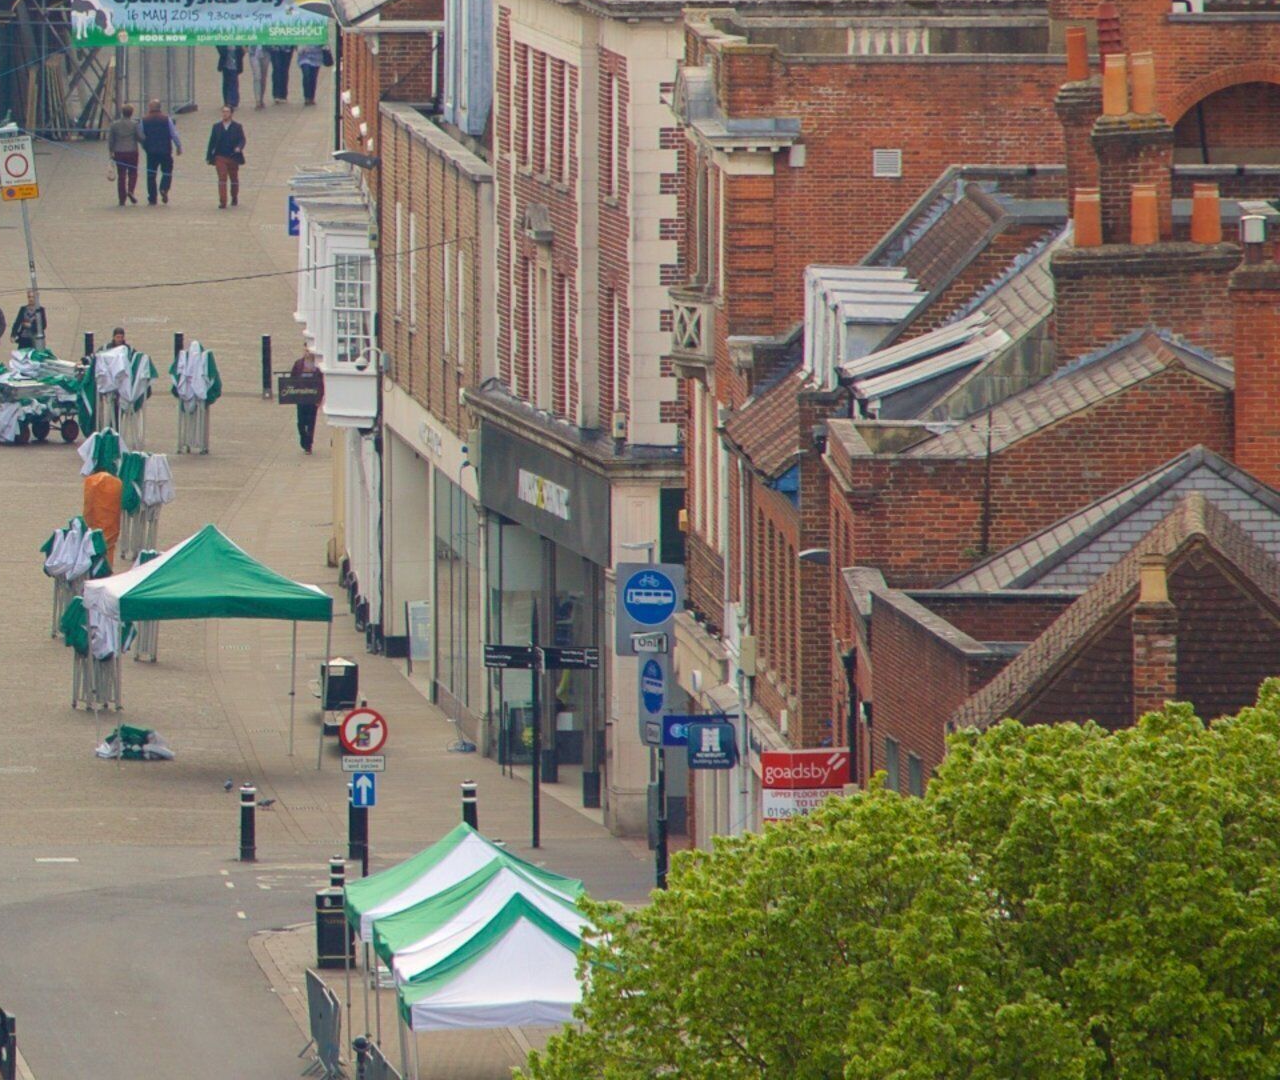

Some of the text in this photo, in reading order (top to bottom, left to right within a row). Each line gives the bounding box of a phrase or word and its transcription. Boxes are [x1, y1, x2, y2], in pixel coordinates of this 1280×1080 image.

[127, 10, 139, 21] 16
[143, 10, 168, 25] MAY
[171, 9, 200, 21] 2015
[252, 11, 273, 24] 5pm
[269, 26, 324, 37] SPARSHOLT
[140, 34, 164, 42] BOOK
[166, 34, 187, 42] NOW
[3, 143, 25, 152] ZONE
[765, 762, 831, 785] goadsby
